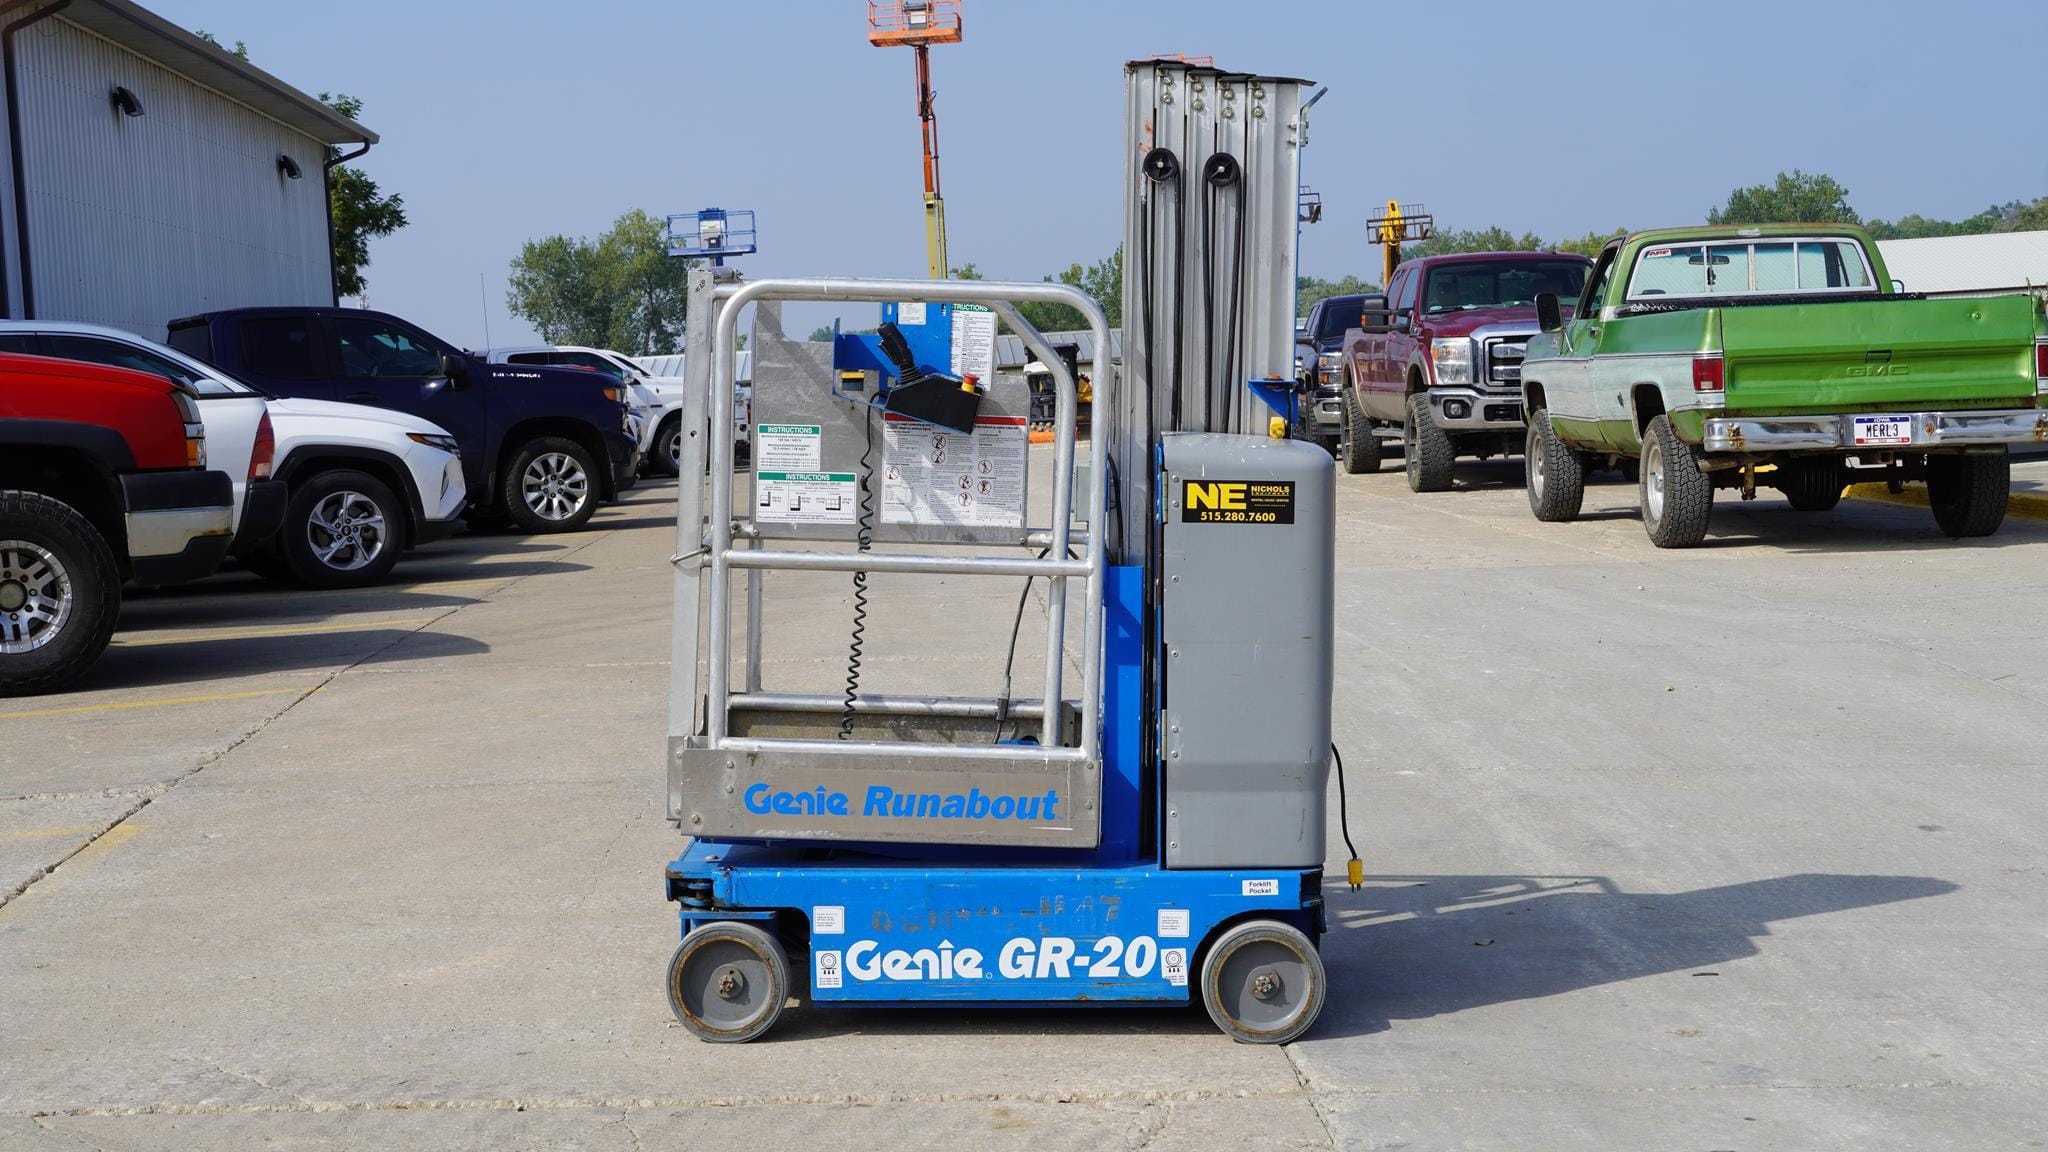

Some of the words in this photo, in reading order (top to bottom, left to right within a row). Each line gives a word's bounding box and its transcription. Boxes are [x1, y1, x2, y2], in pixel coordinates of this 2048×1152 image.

[952, 303, 989, 312] TRUCTIONS
[1847, 364, 1909, 377] GMC
[767, 426, 813, 434] INSTRUCTIONS
[1866, 423, 1899, 438] MERL3
[785, 473, 831, 481] INSTRUCTIONS
[1251, 485, 1290, 493] NICHOLS
[1186, 482, 1248, 510] NE
[1200, 511, 1276, 522] 515.280.7600
[744, 783, 849, 816] Genie
[863, 785, 1059, 822] Runabout
[845, 938, 984, 981] Genie
[998, 935, 1157, 979] GR-20
